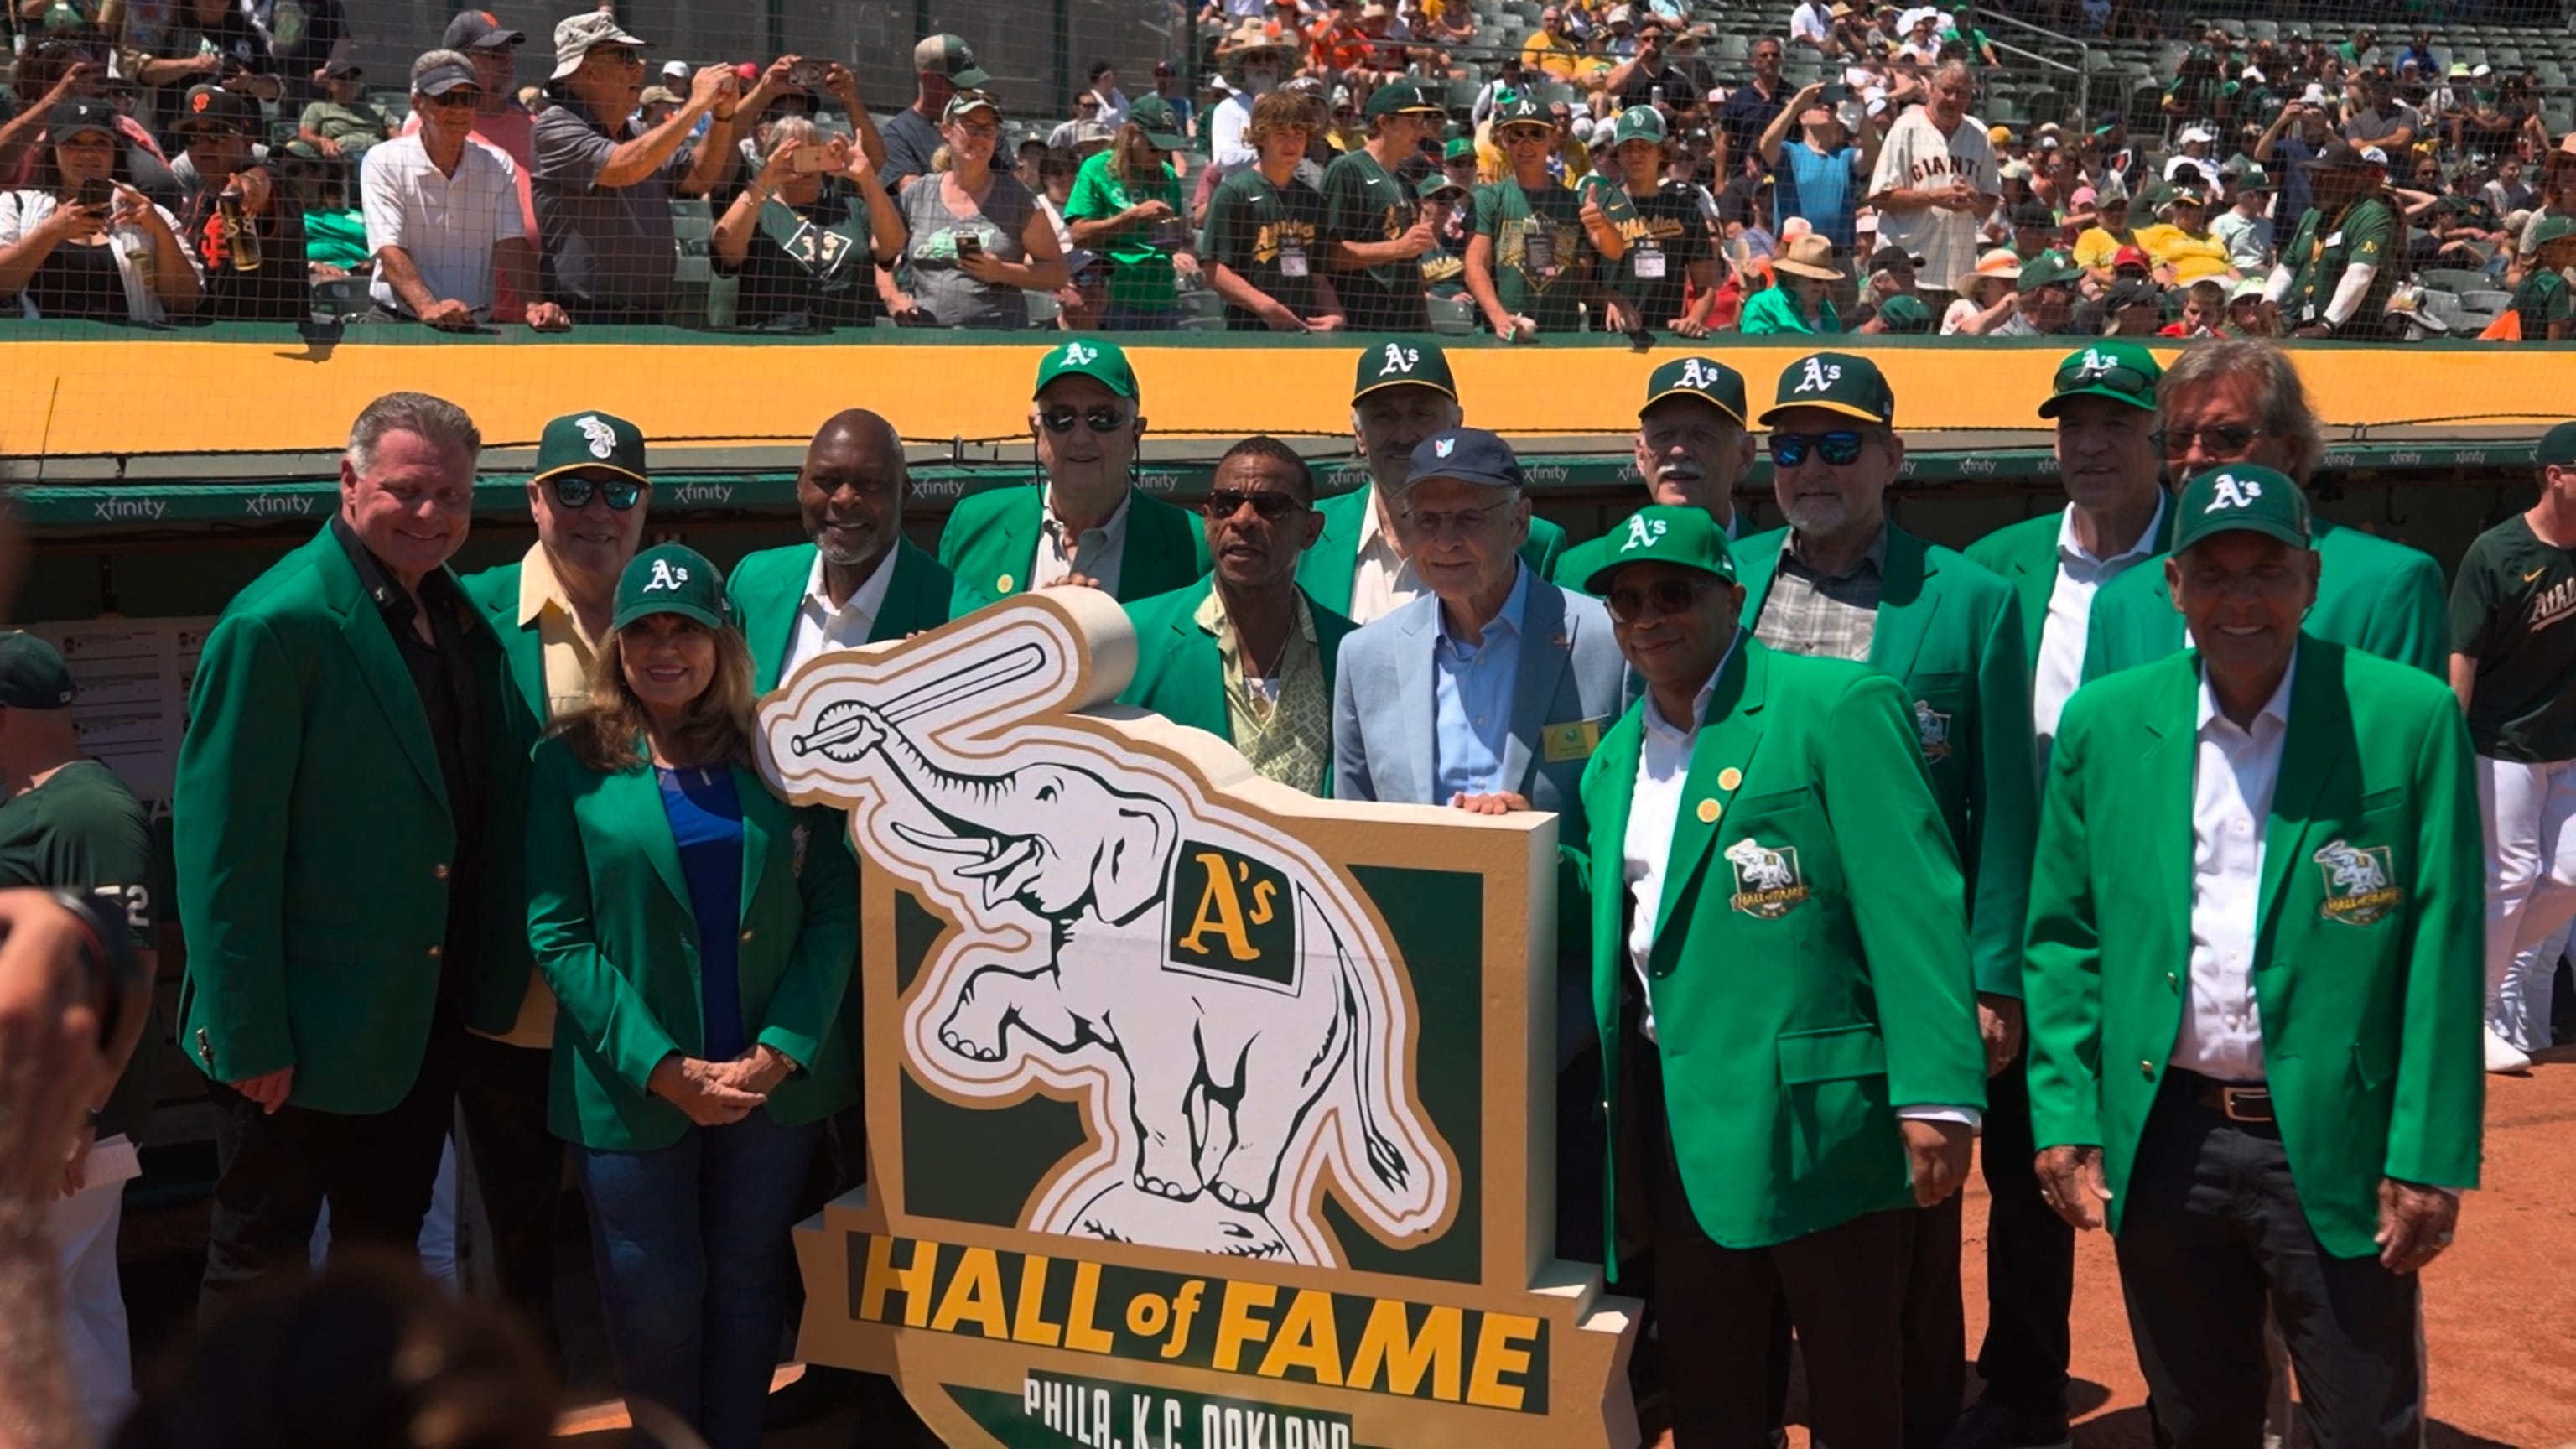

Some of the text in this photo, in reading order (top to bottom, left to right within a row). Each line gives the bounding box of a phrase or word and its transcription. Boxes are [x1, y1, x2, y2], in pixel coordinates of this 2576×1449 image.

[1059, 341, 1098, 367] A's
[1379, 342, 1420, 376] A's
[2076, 348, 2119, 377] A's
[1673, 358, 1718, 390] A's
[1794, 357, 1842, 394] A's
[1958, 458, 1997, 475] xfinity
[2323, 453, 2355, 467] xfinity
[2389, 451, 2422, 465] xfinity
[911, 477, 965, 497] xfinity
[1134, 472, 1178, 491] finity
[1524, 465, 1569, 483] xfinity
[245, 493, 314, 517] xfinity
[674, 482, 733, 503] xfinity
[2204, 474, 2262, 514] A's
[94, 496, 166, 520] xfinity
[1620, 513, 1667, 553] A's
[642, 558, 688, 593] A's
[1178, 852, 1277, 961] A's
[859, 1234, 1542, 1411] HALL of FAME
